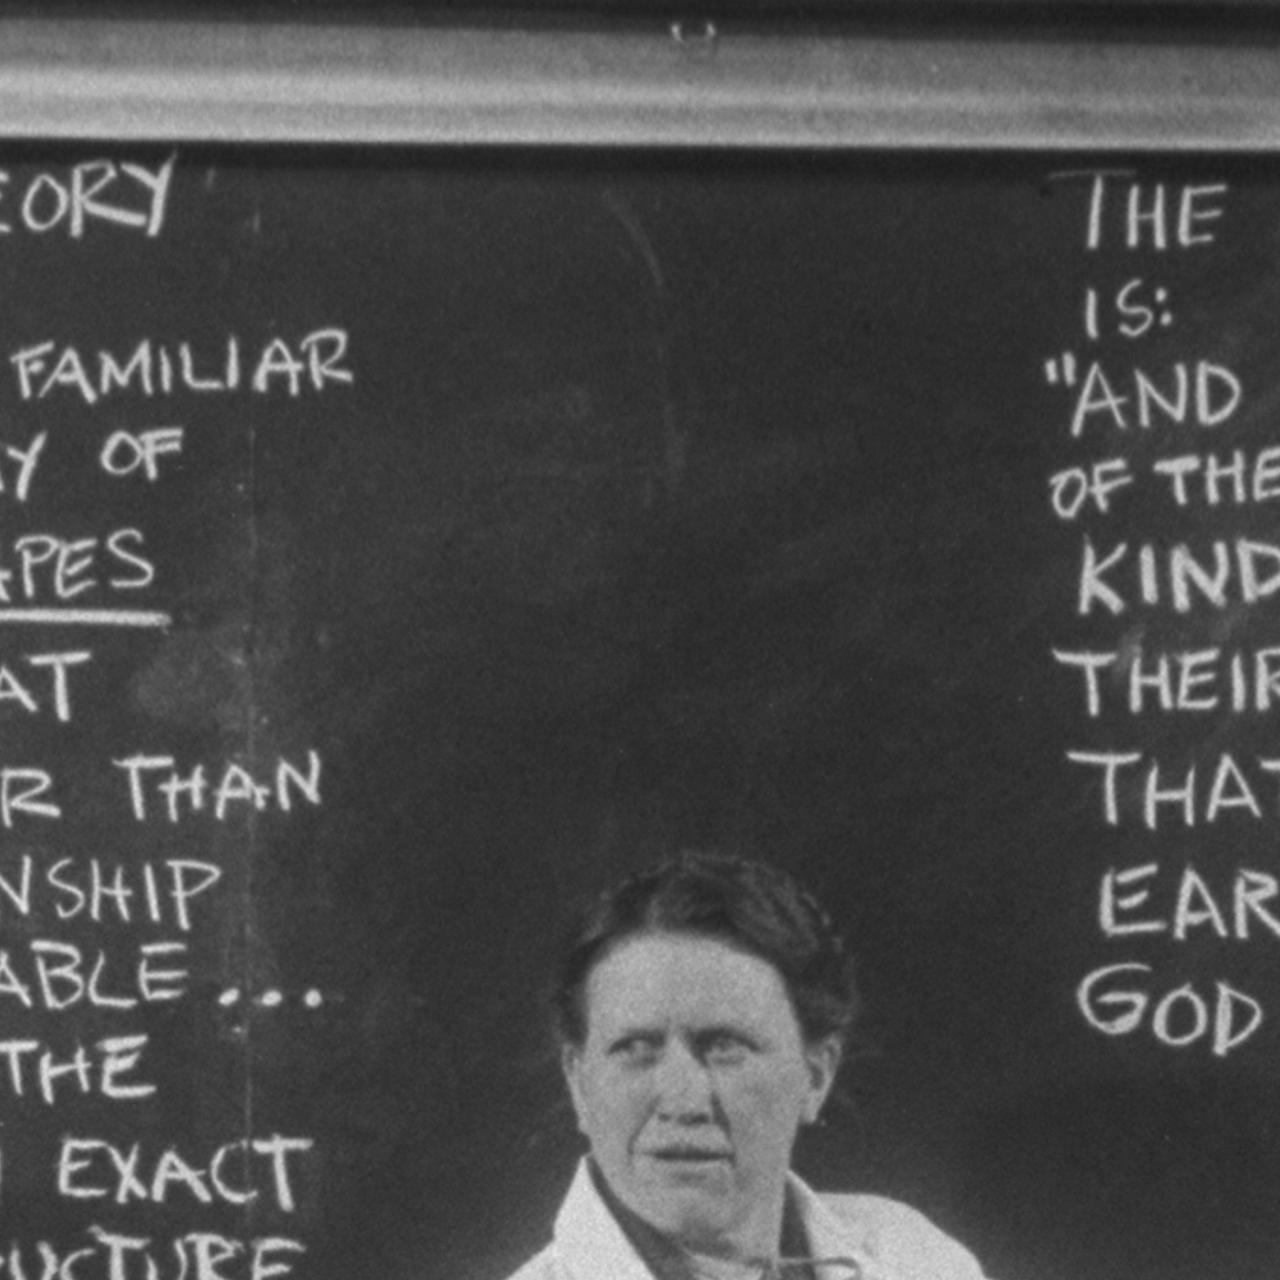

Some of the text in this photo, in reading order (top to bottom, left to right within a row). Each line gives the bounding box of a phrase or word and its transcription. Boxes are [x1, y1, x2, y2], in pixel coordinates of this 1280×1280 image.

[1047, 168, 1230, 254] THE
[1084, 278, 1173, 340] IS:
[9, 327, 353, 405] FAMILIAR
[99, 427, 184, 481] OF
[1049, 457, 1133, 520] OF
[113, 750, 321, 823] THAN
[1076, 962, 1263, 1057] GOD
[57, 1133, 313, 1212] EXACT
